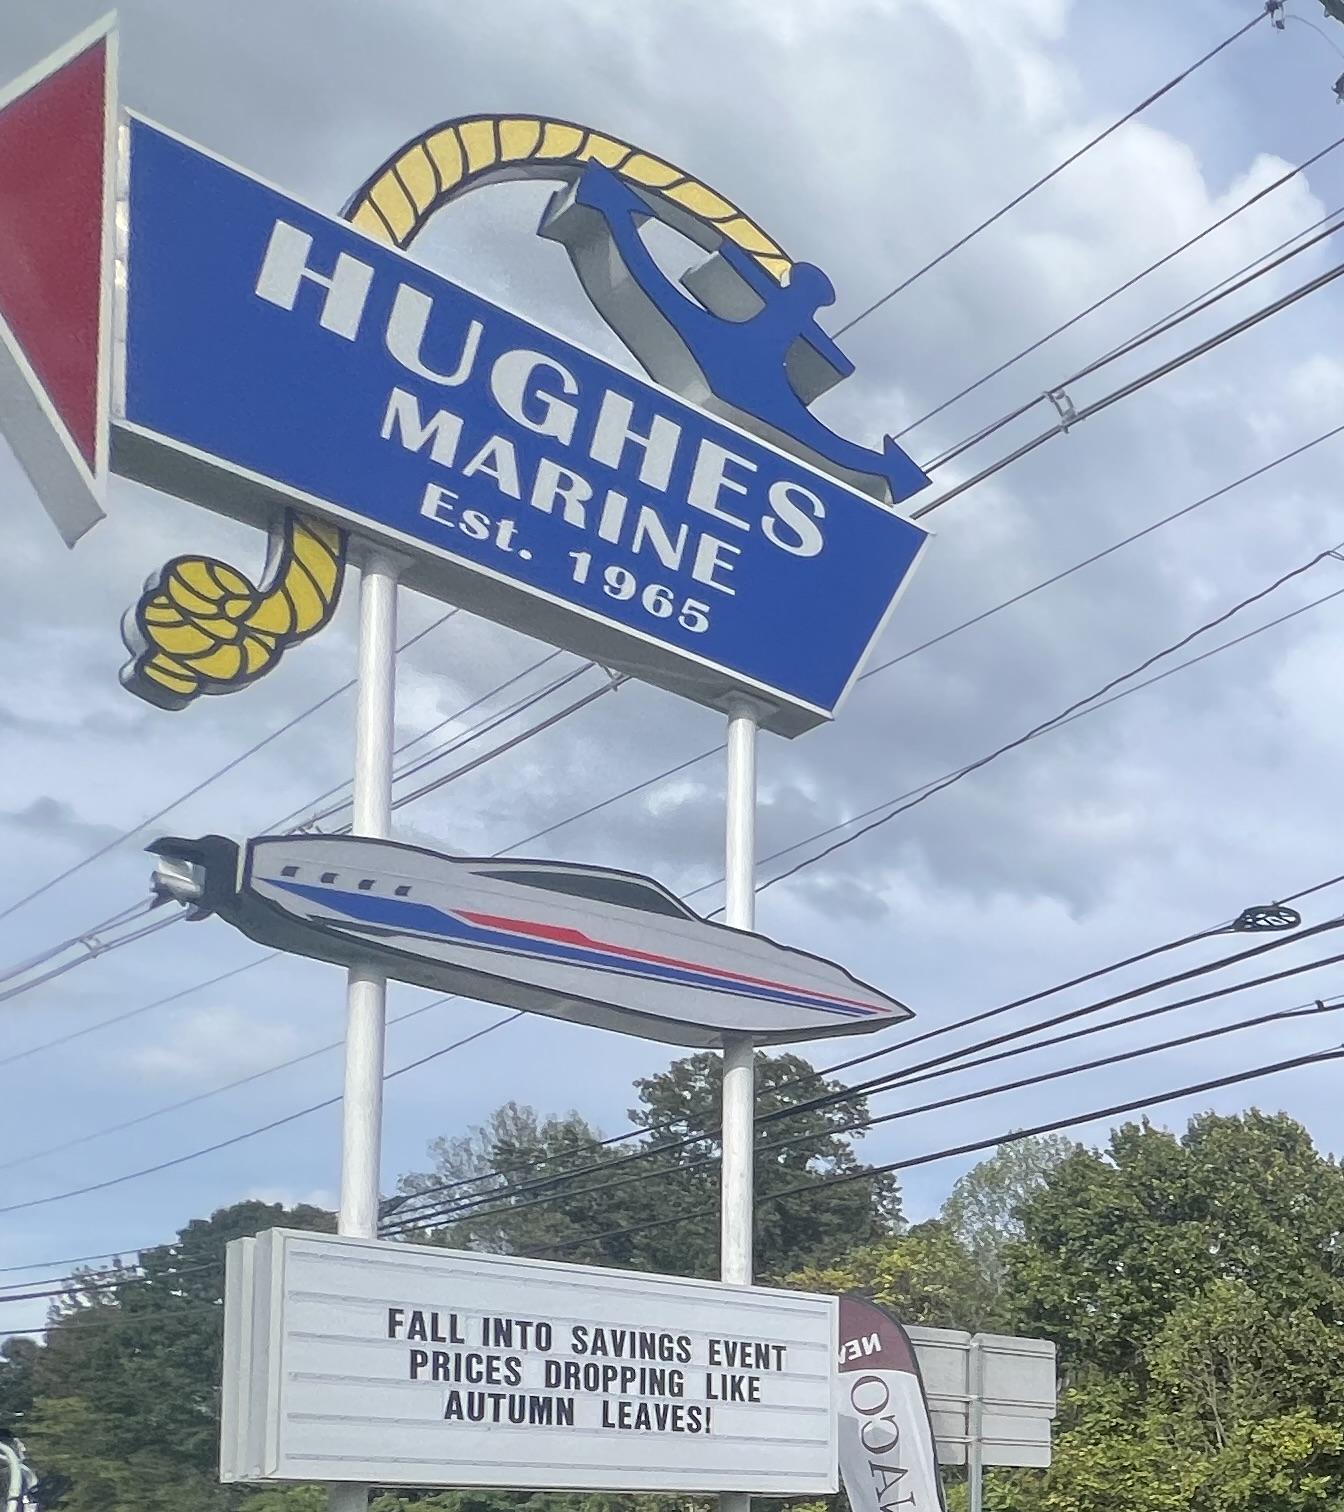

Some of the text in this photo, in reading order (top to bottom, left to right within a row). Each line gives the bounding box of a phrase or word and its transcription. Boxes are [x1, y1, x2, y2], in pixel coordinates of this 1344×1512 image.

[255, 219, 826, 559] HUGHES
[379, 387, 743, 597] MARINE
[419, 482, 711, 634] Est. 1965
[388, 1308, 787, 1371] FALL INTO SAVINGS EVENT
[410, 1349, 761, 1403] PRICES DROPPING LIKE
[444, 1390, 711, 1434] AUTUMN LEAVES!
